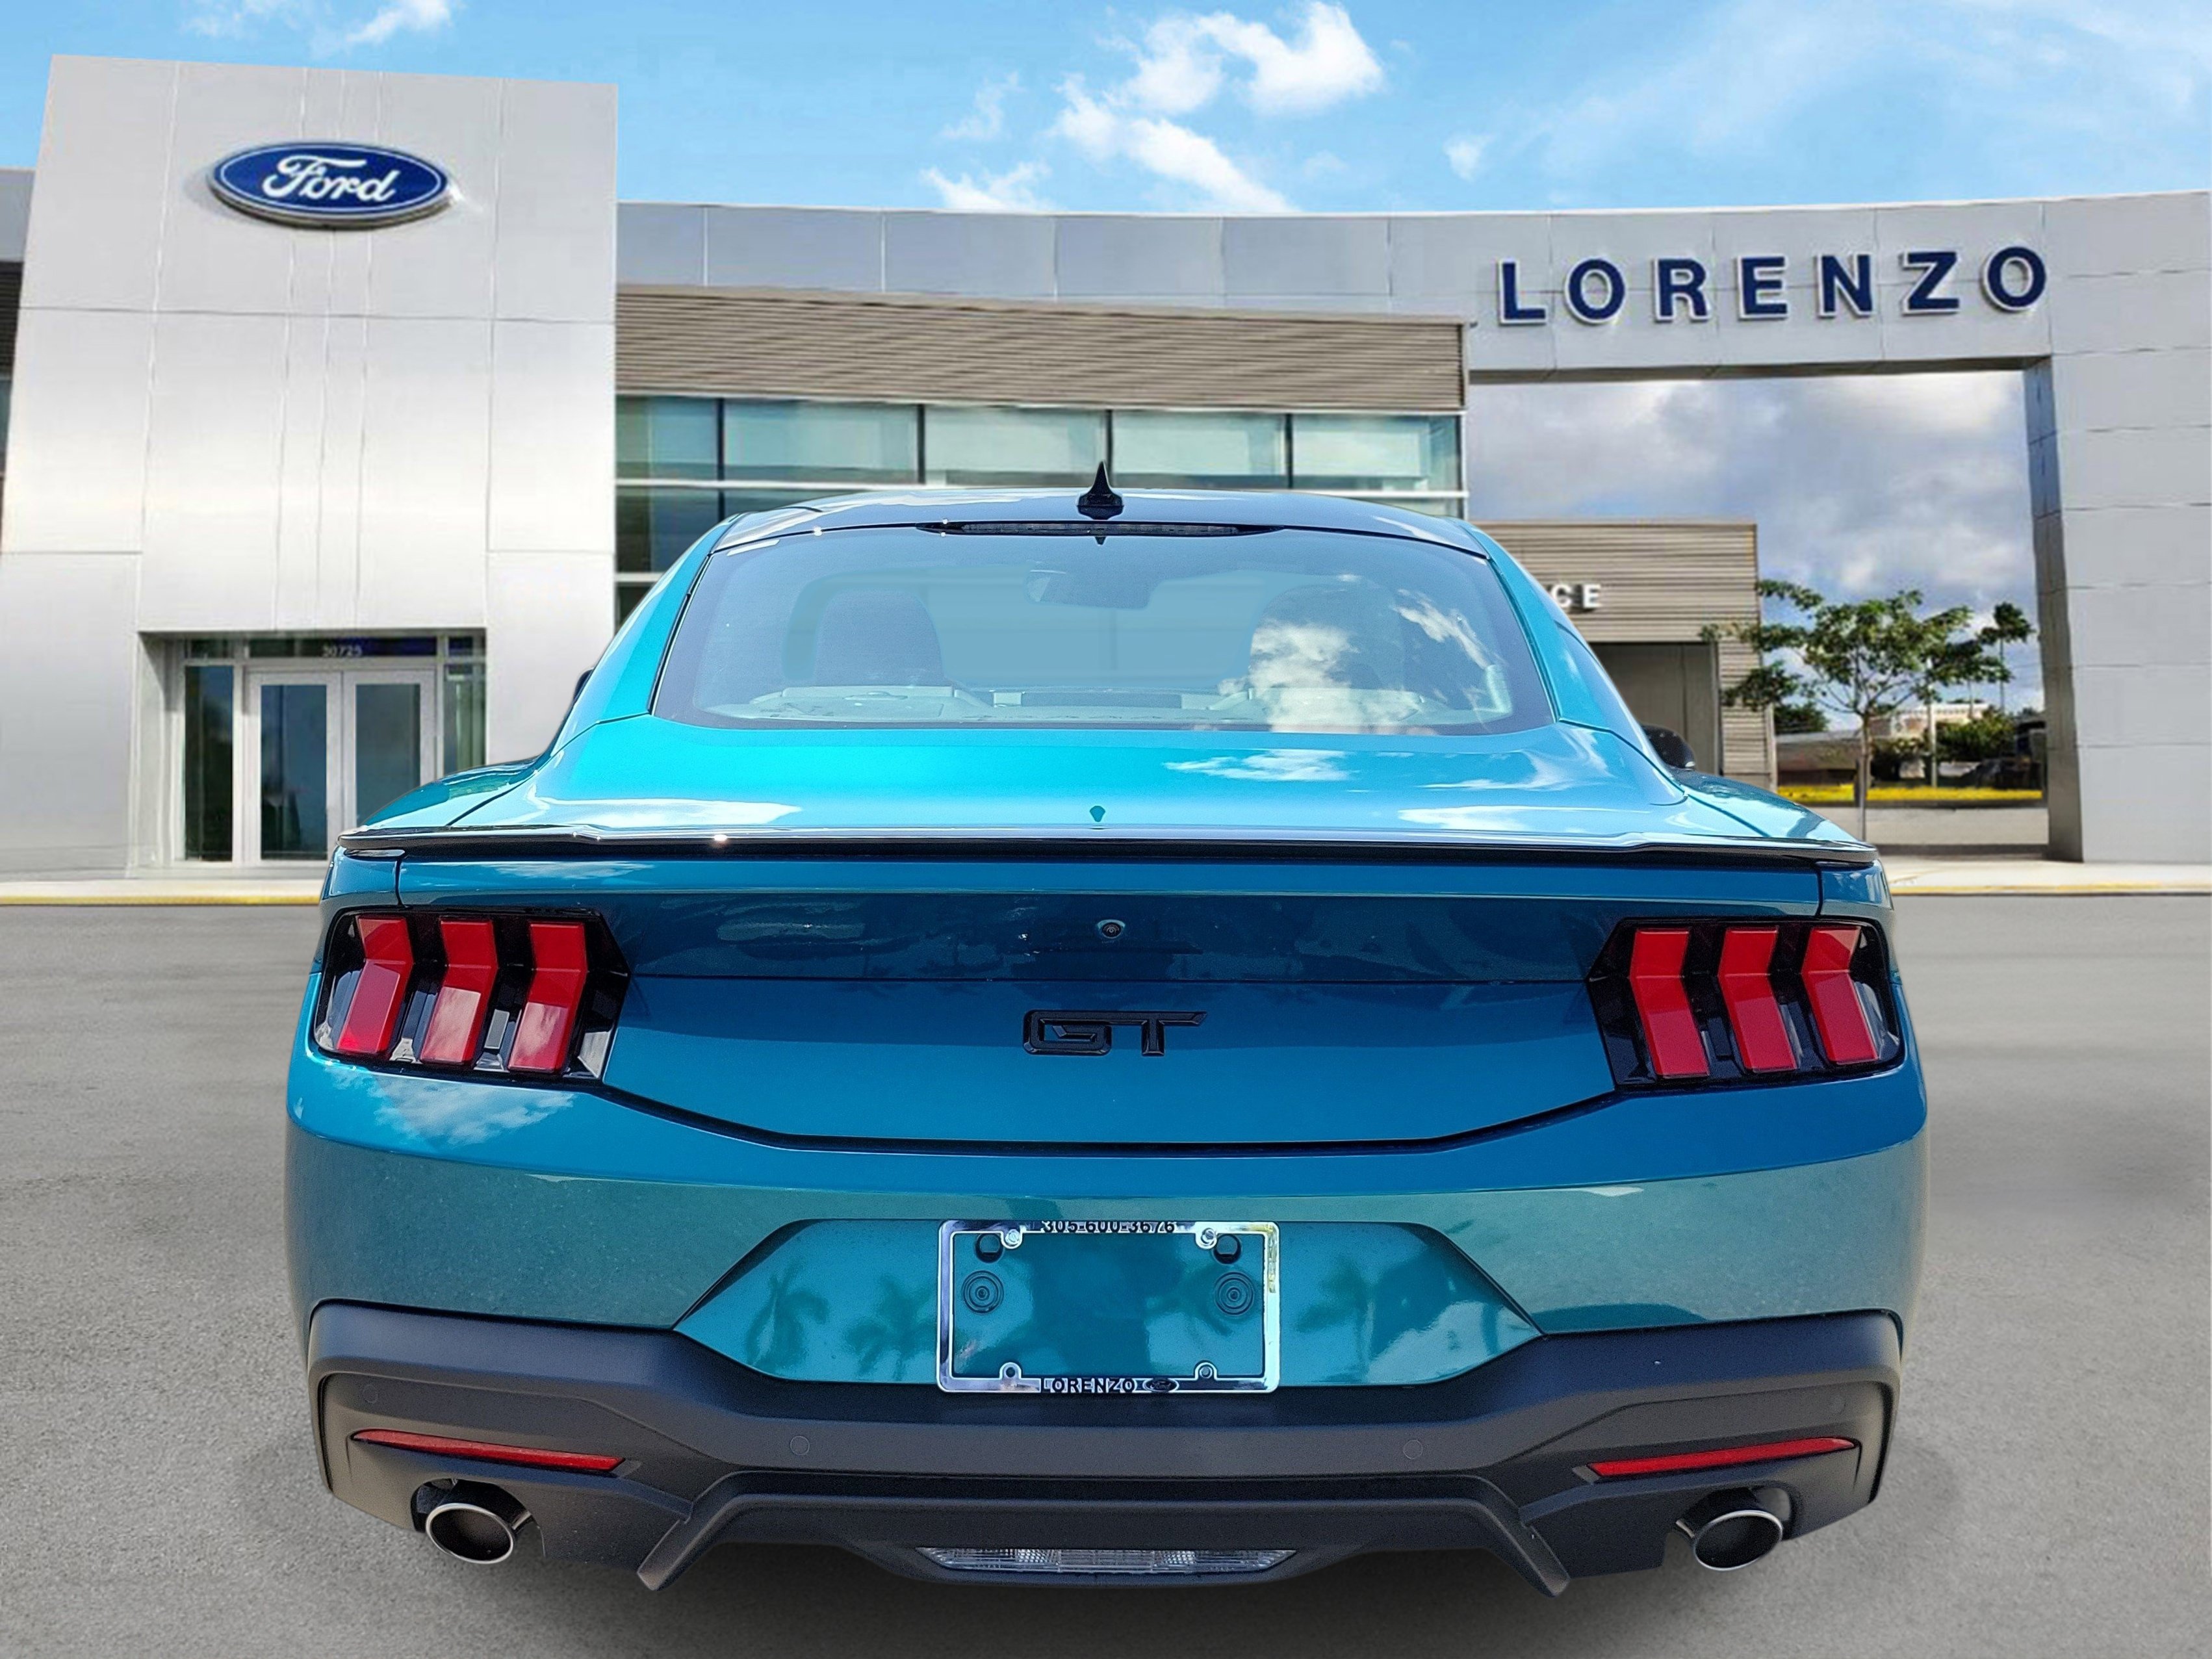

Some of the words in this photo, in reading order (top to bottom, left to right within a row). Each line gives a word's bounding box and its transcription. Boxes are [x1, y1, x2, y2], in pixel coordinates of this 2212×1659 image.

[263, 155, 400, 201] Ford
[1498, 246, 2046, 325] LORENZO
[1023, 1009, 1208, 1057] GT
[1041, 1220, 1175, 1233] 305-600-3676
[1041, 1377, 1135, 1393] LORENZO
